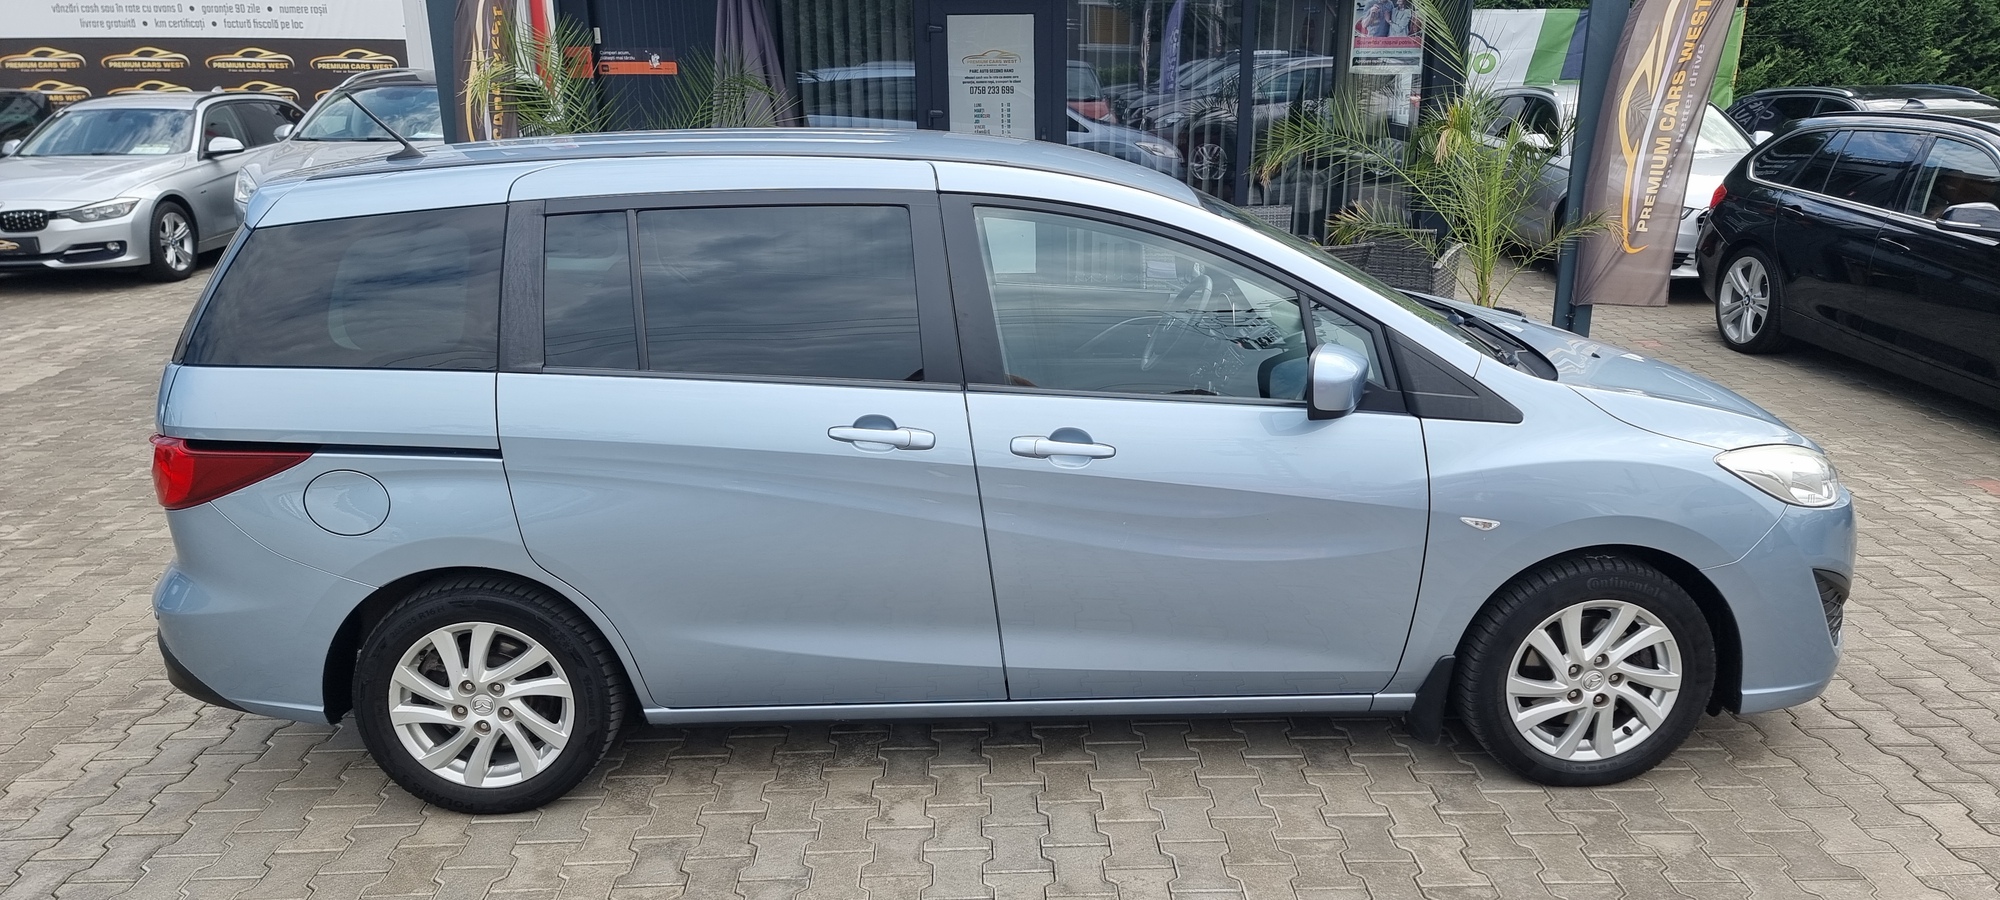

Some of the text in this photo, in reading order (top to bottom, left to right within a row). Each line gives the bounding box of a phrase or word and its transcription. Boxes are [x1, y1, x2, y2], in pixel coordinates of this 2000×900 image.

[81, 3, 99, 13] cash
[125, 4, 140, 13] rate
[142, 5, 152, 13] cu
[153, 5, 176, 13] avans
[235, 4, 245, 13] 90
[247, 4, 260, 13] zile
[279, 5, 308, 14] numere
[79, 19, 104, 28] livrare
[154, 19, 166, 28] km
[223, 19, 251, 29] factură
[281, 21, 290, 30] pe
[292, 19, 304, 29] loc
[108, 61, 140, 69] PREMIUM
[141, 61, 161, 69] CARS
[988, 86, 999, 94] 233
[1676, 92, 1694, 143] better
[1689, 43, 1706, 87] drive
[48, 94, 64, 102] ARS
[1636, 0, 1712, 233] PREMIUM CARS WEST
[1586, 577, 1660, 597] Continental
[418, 608, 436, 620] R16
